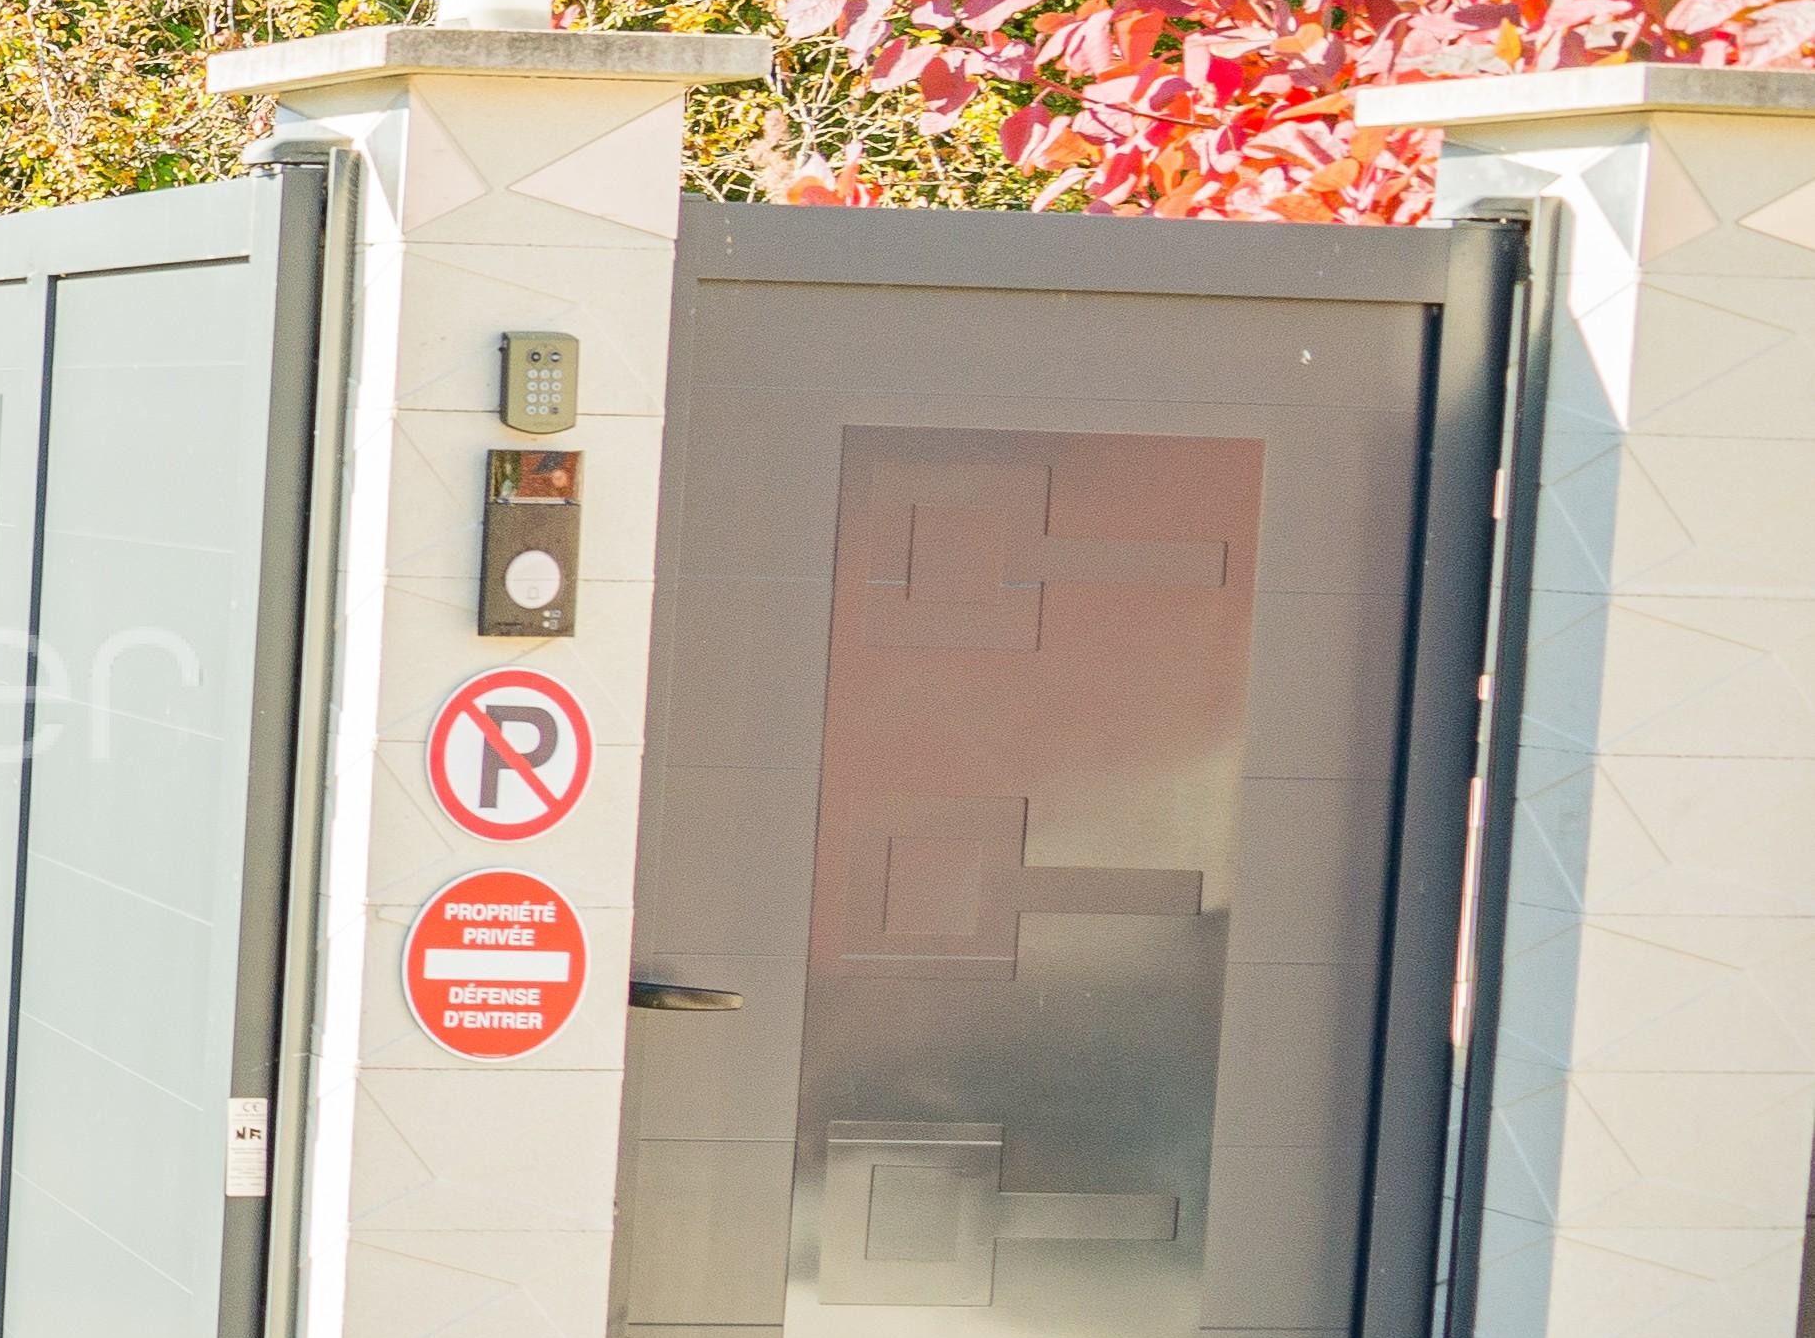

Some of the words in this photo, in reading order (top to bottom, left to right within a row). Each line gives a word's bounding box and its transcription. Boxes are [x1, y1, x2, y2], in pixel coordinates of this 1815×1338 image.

[478, 704, 559, 810] P
[444, 900, 557, 923] PROPRIÉTÉ
[462, 924, 536, 947] PRIVÉE
[448, 982, 542, 1006] DÉFENSE
[443, 1010, 543, 1030] D'ENTRER
